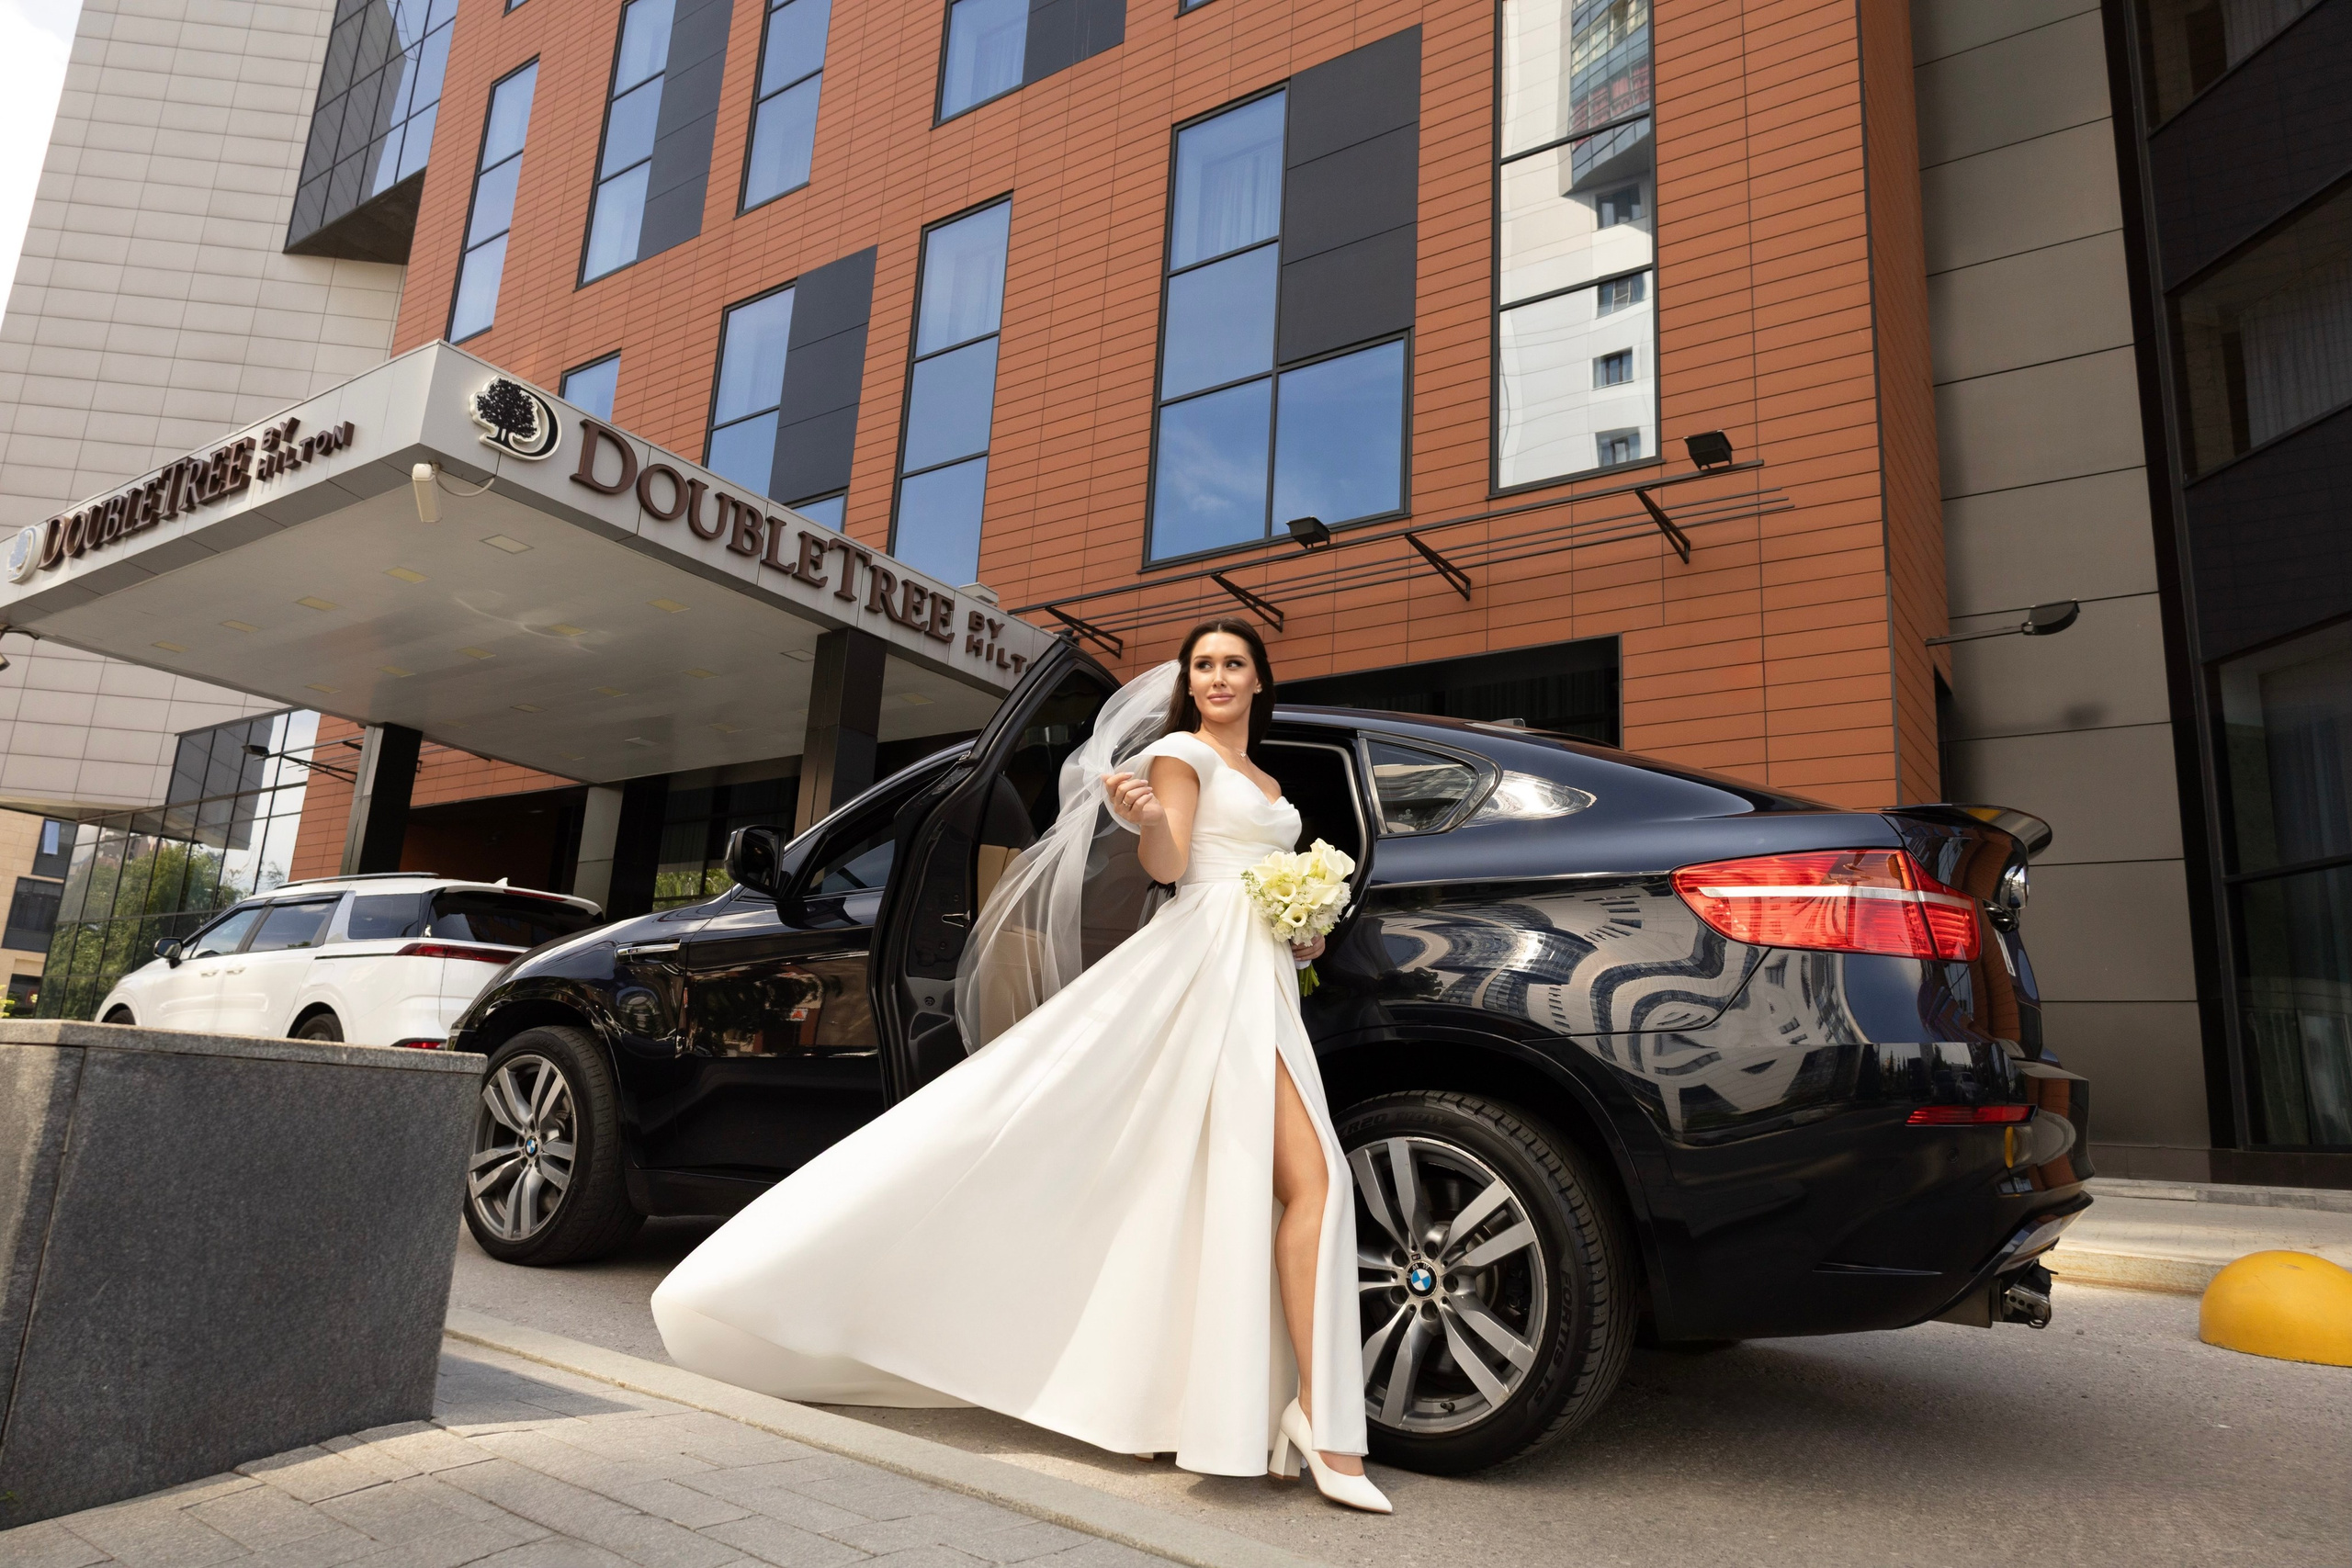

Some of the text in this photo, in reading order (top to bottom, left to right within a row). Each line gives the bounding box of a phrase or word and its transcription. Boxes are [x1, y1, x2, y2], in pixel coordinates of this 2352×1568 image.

[256, 421, 355, 481] HILTON
[261, 417, 300, 452] BY
[38, 436, 256, 570] DOUBLETREE
[570, 418, 956, 644] DOUBLETREE
[967, 610, 1005, 639] BY
[966, 634, 1035, 673] HILT
